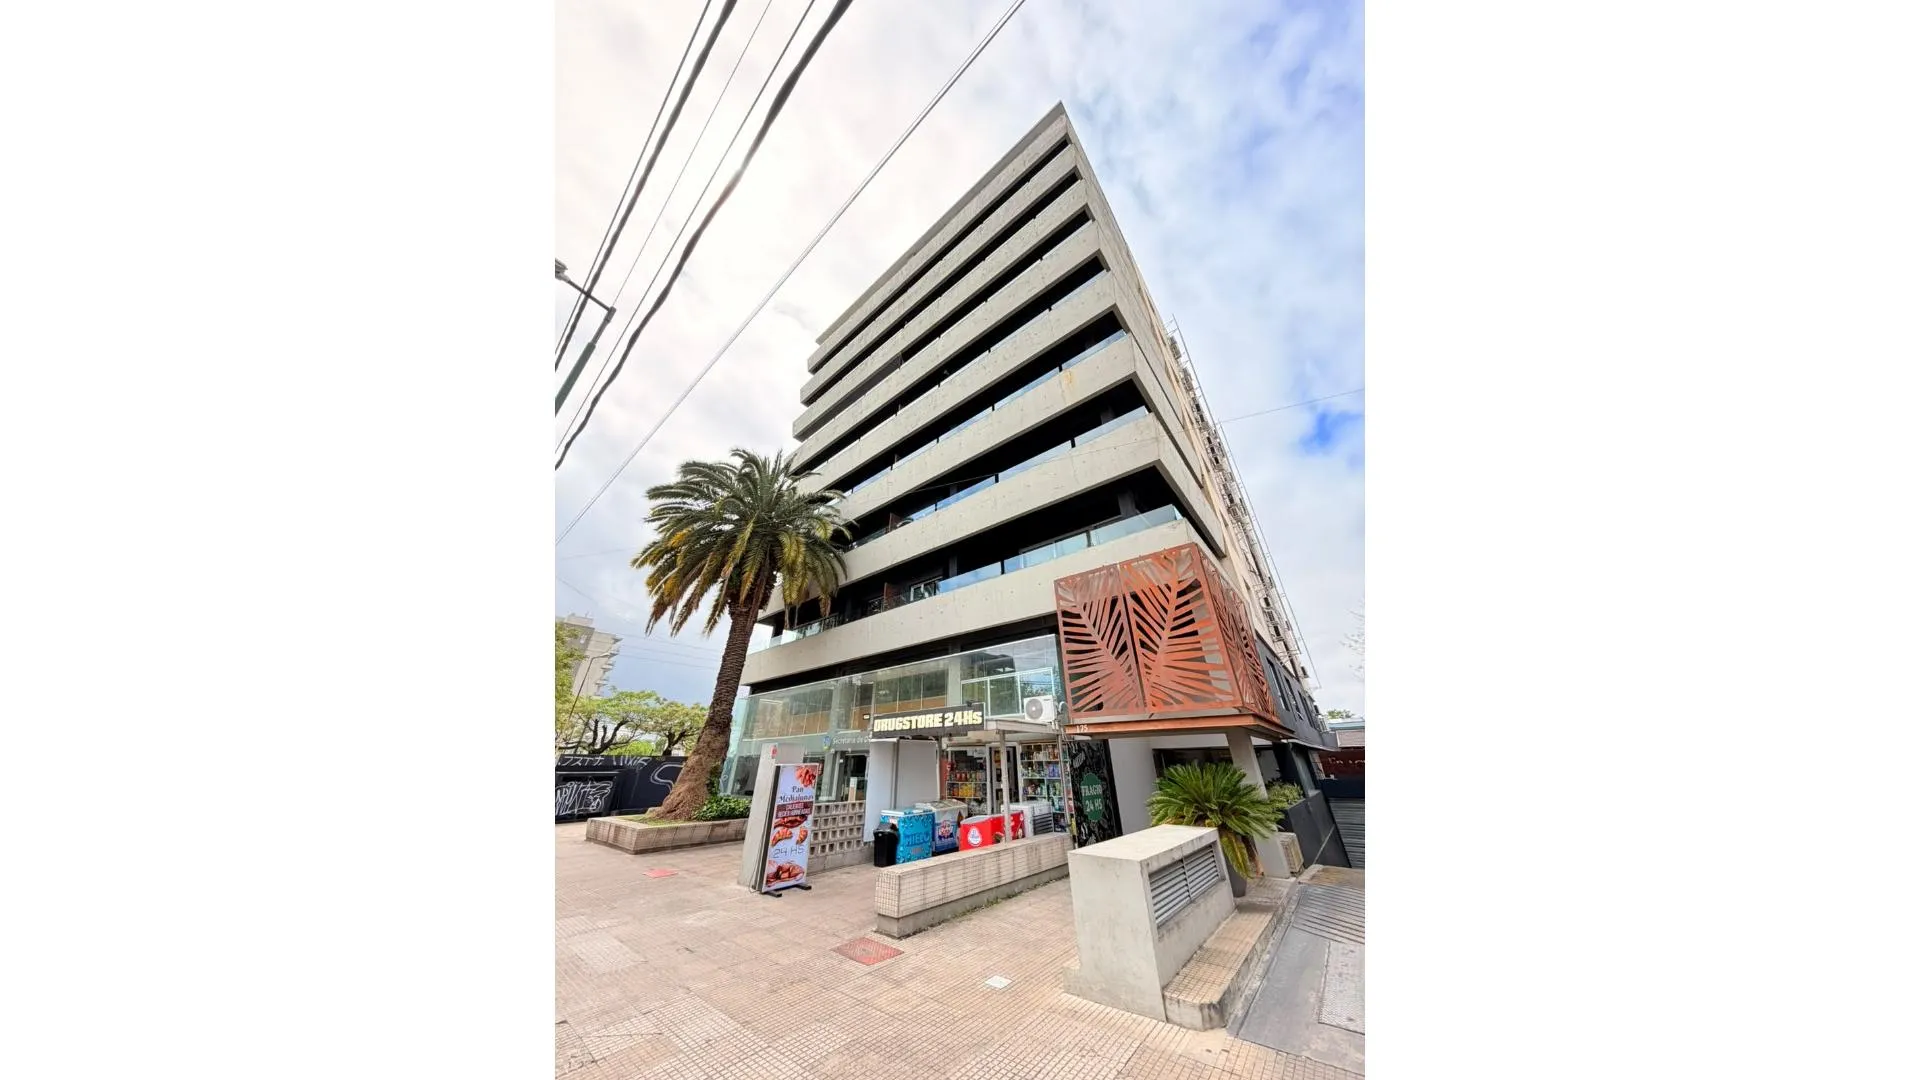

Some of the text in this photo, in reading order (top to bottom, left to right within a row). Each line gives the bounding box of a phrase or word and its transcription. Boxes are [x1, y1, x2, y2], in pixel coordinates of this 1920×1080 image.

[874, 711, 982, 731] DRUGSTORE 24Hs
[792, 785, 804, 793] Pan
[1085, 798, 1103, 812] 24 HS
[773, 848, 787, 858] 24
